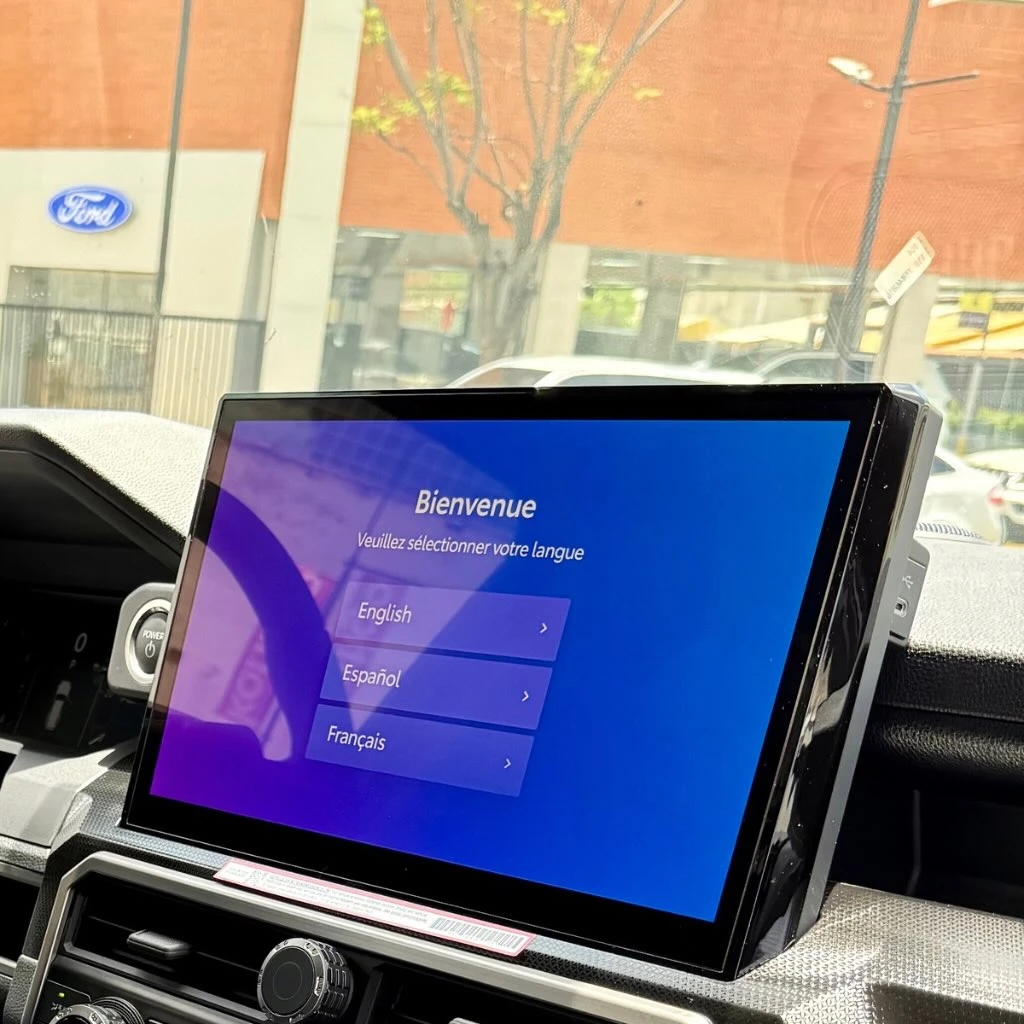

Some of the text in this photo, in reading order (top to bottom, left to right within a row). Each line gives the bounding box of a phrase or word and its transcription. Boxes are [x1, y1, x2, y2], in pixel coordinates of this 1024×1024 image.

[57, 192, 120, 227] Ford
[414, 489, 537, 518] Bienvenue
[357, 532, 585, 563] Veuillez sélectionner votre langue
[357, 602, 412, 625] English
[142, 629, 165, 641] POWER
[342, 663, 401, 689] Español
[326, 724, 386, 752] Français
